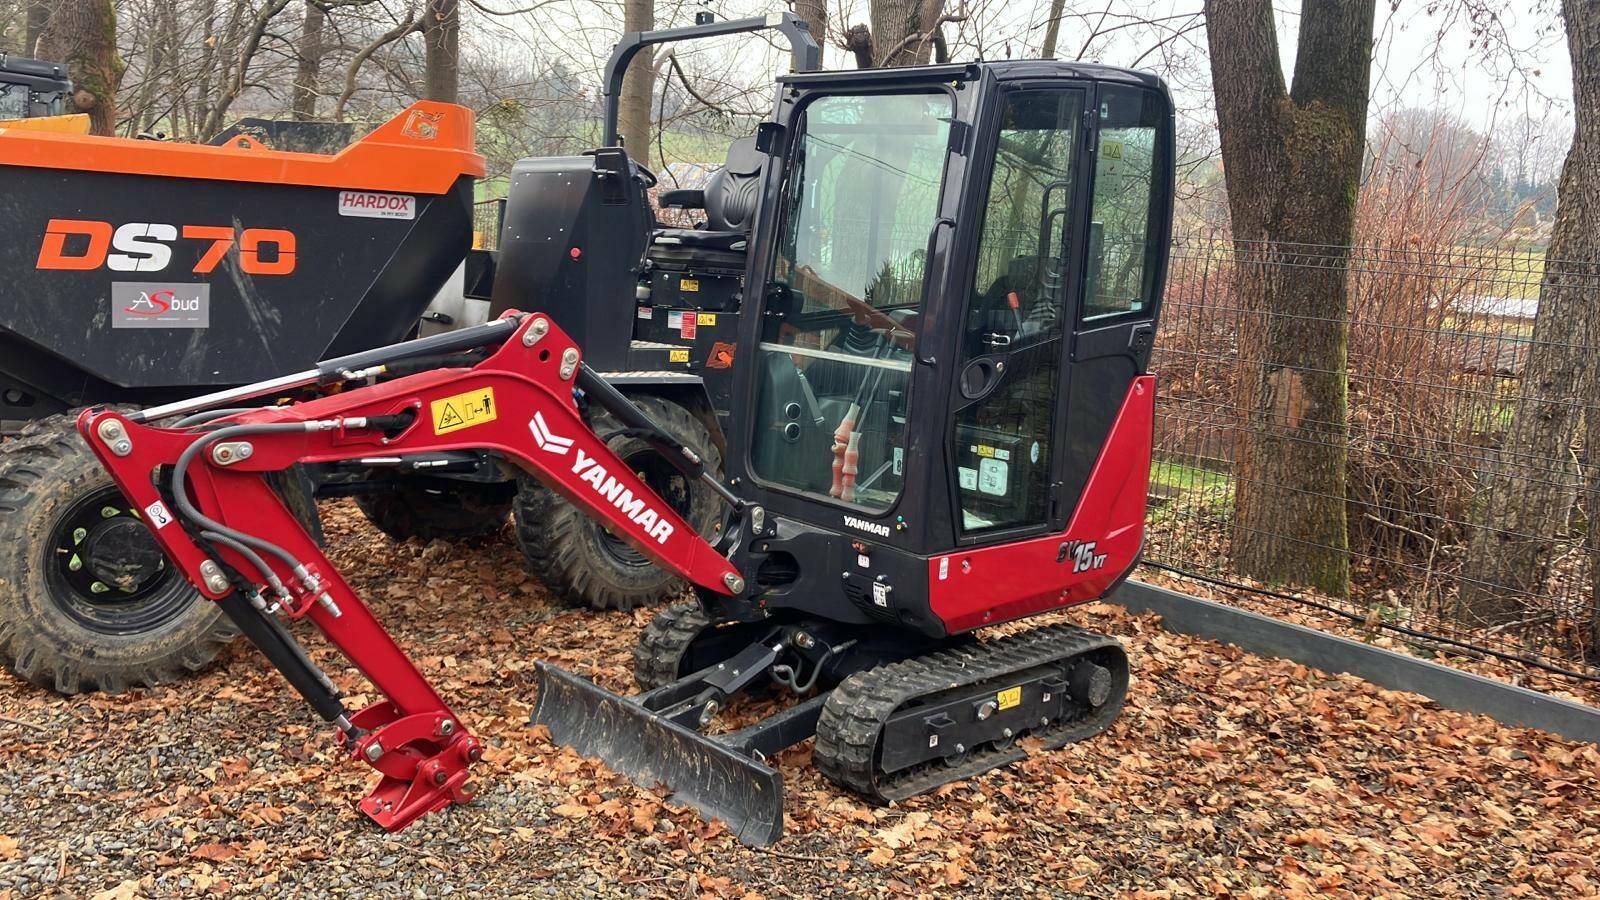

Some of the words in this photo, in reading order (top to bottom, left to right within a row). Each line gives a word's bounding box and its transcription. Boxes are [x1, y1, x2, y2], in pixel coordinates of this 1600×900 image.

[343, 193, 409, 210] HARDOX
[571, 449, 674, 544] YANMAR
[843, 515, 890, 537] YANMAR
